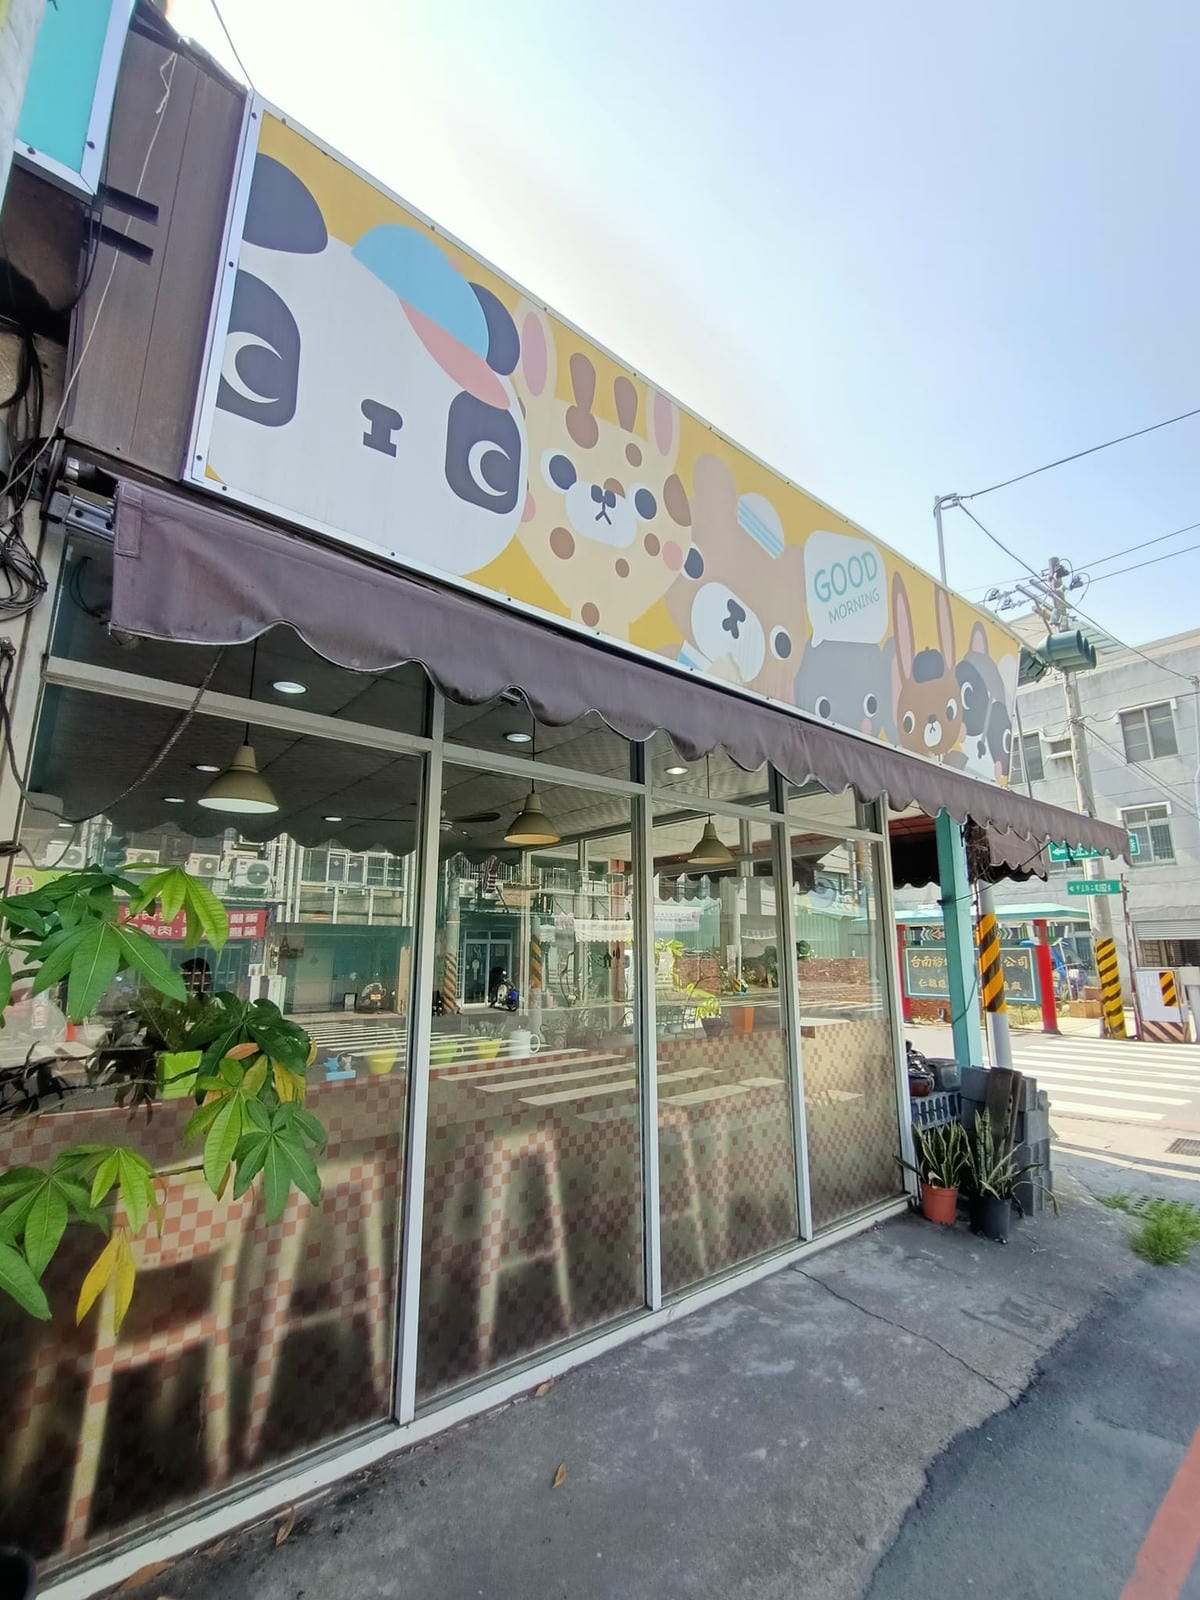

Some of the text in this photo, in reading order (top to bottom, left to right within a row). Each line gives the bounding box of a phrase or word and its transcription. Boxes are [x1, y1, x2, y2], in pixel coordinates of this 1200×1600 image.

[814, 552, 877, 602] GOOD
[828, 587, 880, 624] MORNING
[910, 955, 1028, 969] 台南紡 公司
